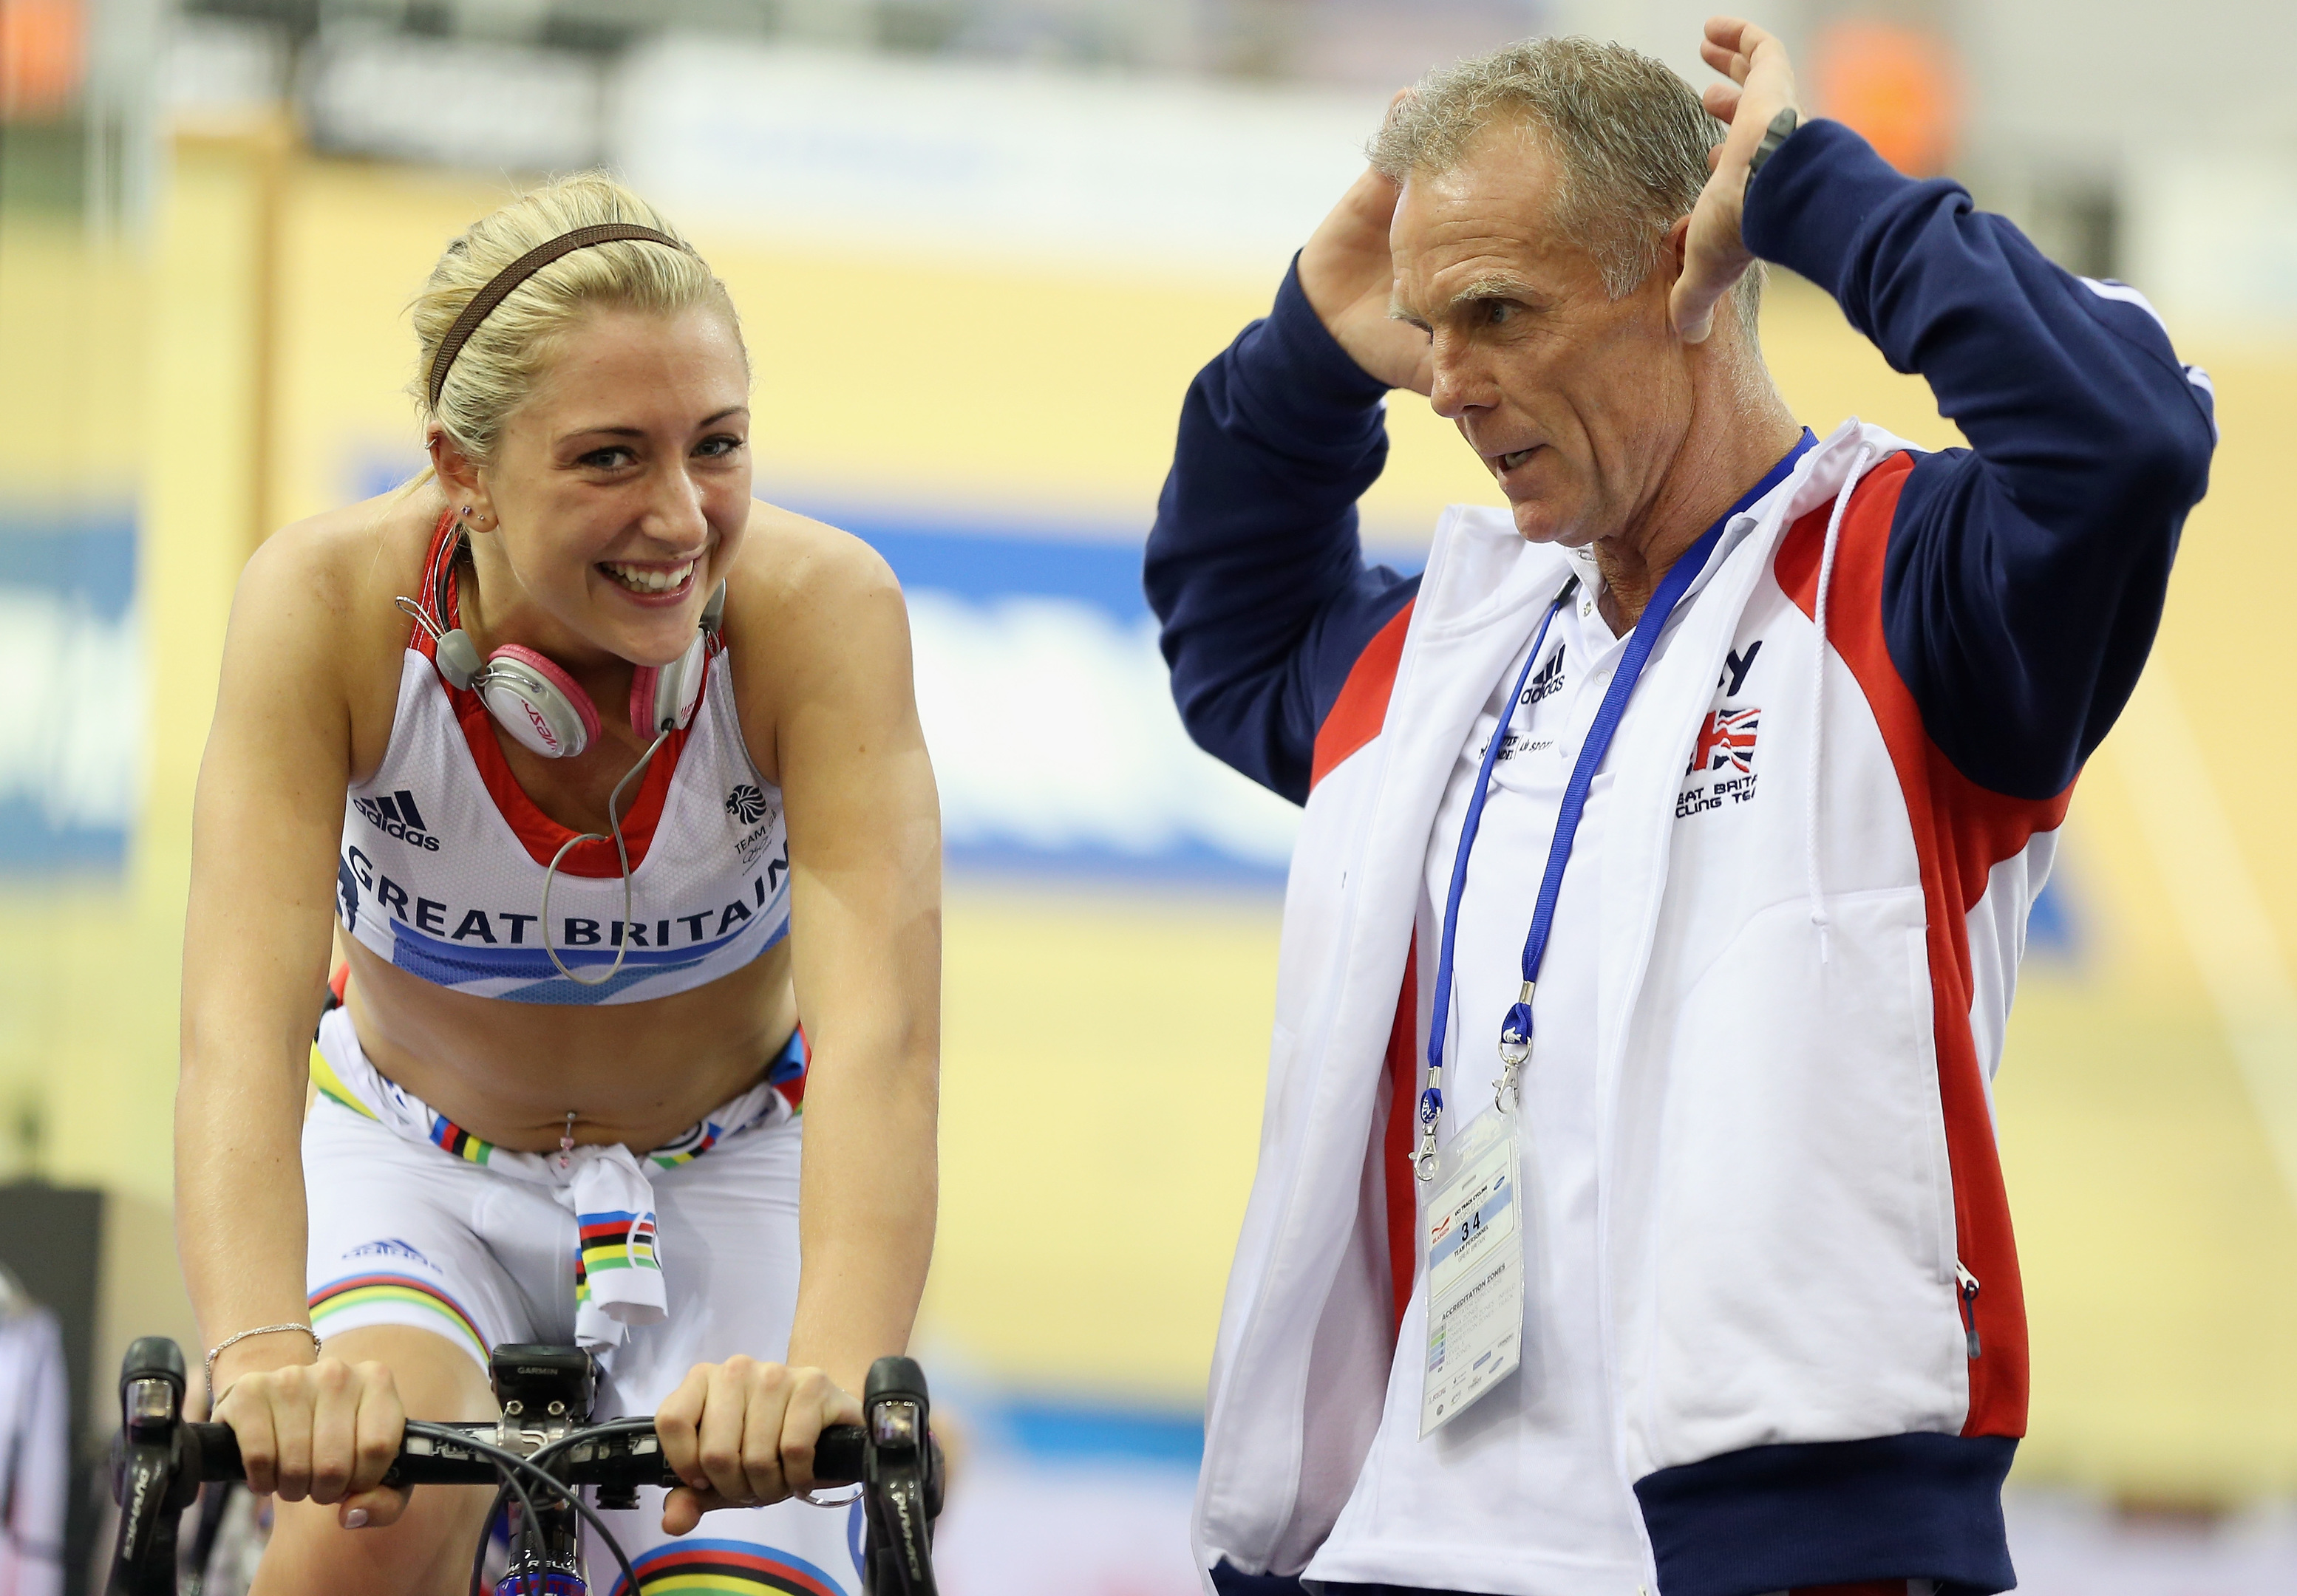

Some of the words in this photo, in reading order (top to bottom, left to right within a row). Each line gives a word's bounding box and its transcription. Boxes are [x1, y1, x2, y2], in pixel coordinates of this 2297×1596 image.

[1521, 675, 1565, 704] adidas
[1675, 797, 1722, 819] CLING
[353, 799, 440, 851] adidas
[735, 825, 766, 854] TEAM
[349, 845, 537, 945] GREAT
[563, 839, 789, 947] BRITAIN
[1461, 1197, 1473, 1210] TRACK
[1473, 1184, 1488, 1201] CYCLING
[1454, 1202, 1476, 1224] WORLD
[1461, 1221, 1469, 1241] 3
[1472, 1210, 1480, 1230] 4
[1454, 1244, 1466, 1257] TEAM
[1466, 1224, 1489, 1250] PERSONNEL
[1442, 1279, 1486, 1322] ACCREDITATION
[1486, 1262, 1506, 1283] ZONES
[517, 1366, 558, 1376] GARMIN
